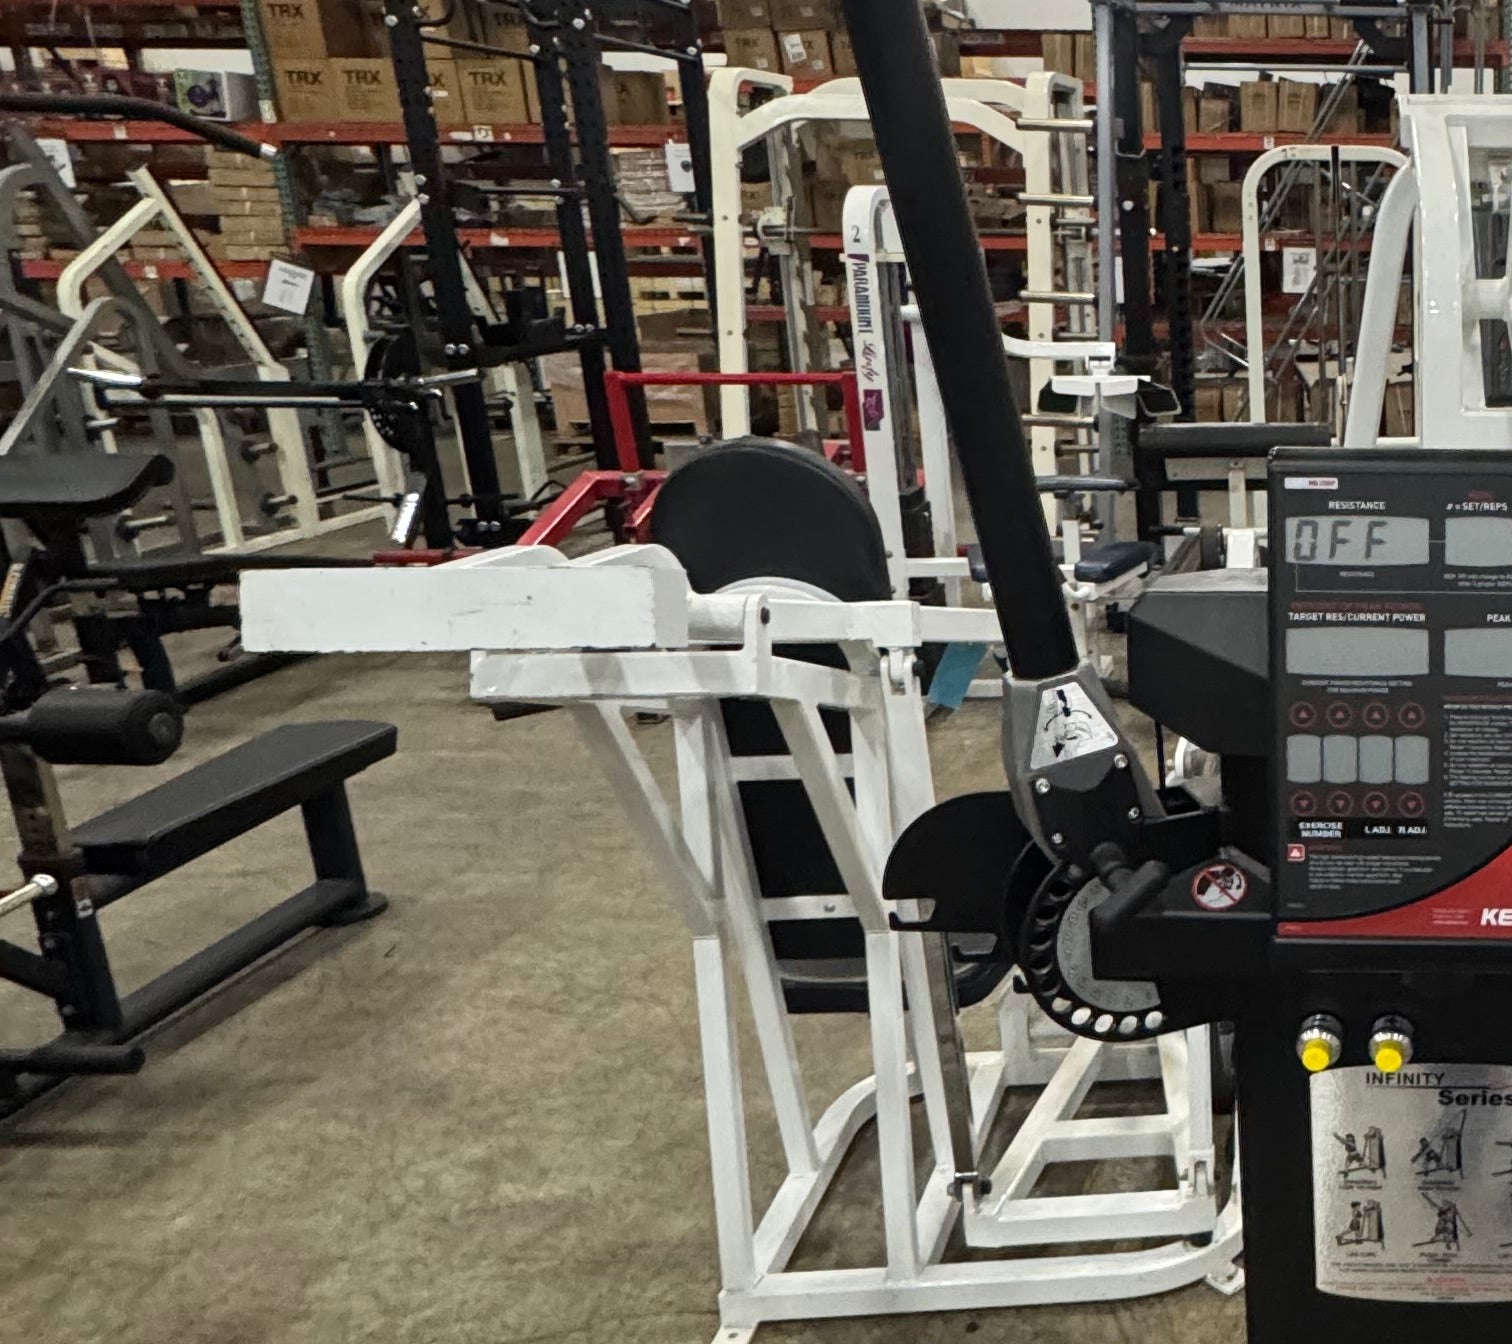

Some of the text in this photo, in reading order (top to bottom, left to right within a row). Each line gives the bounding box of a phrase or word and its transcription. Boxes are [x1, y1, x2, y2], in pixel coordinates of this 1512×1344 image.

[267, 3, 304, 19] TRX
[285, 70, 323, 86] TRX
[343, 69, 382, 85] TRX
[468, 71, 507, 86] TRX
[852, 225, 860, 243] 2
[852, 261, 873, 336] PARAMOUNT
[1328, 501, 1386, 510] RESISTANCE
[1462, 502, 1508, 511] SET/REPS
[1288, 612, 1323, 621] TARGET
[1392, 613, 1426, 622] POWER
[1486, 613, 1511, 623] PEAK
[1301, 830, 1342, 839] NUMBER
[1366, 1072, 1445, 1085] INFINITY
